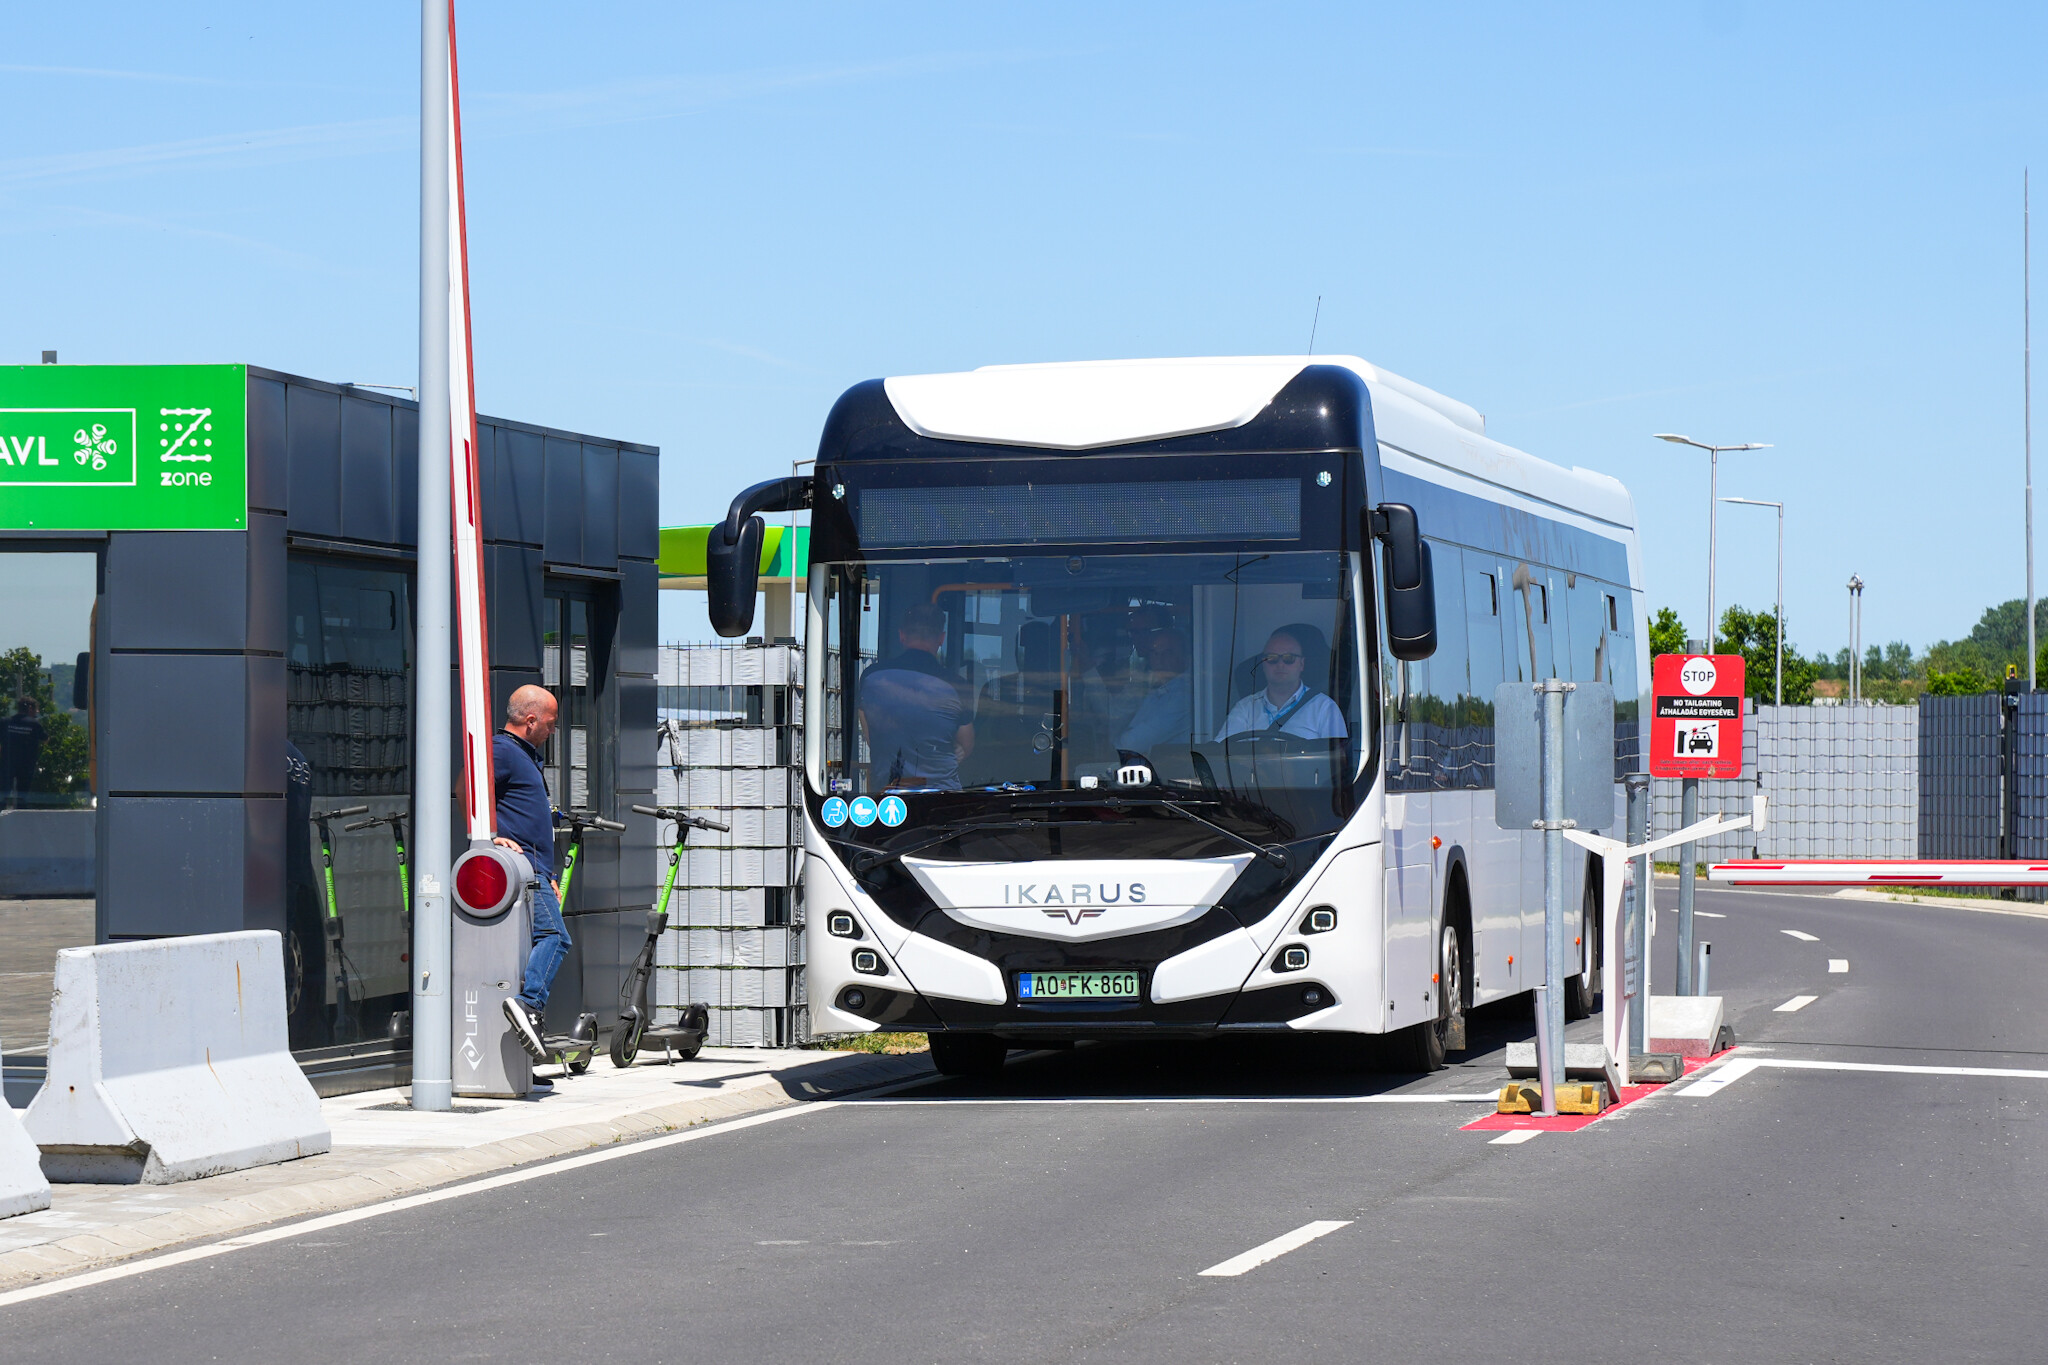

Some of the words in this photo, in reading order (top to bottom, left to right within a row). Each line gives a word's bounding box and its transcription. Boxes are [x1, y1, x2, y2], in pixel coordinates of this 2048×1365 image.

[160, 471, 213, 487] zone
[1682, 670, 1715, 682] STOP
[1673, 699, 1684, 707] NO
[1685, 699, 1722, 707] TAILGATING
[1660, 706, 1698, 716] ÁTHALADÁS
[1699, 707, 1735, 716] EGYESÉVEL
[1004, 883, 1146, 904] IKARUS
[465, 990, 478, 1036] LIFE
